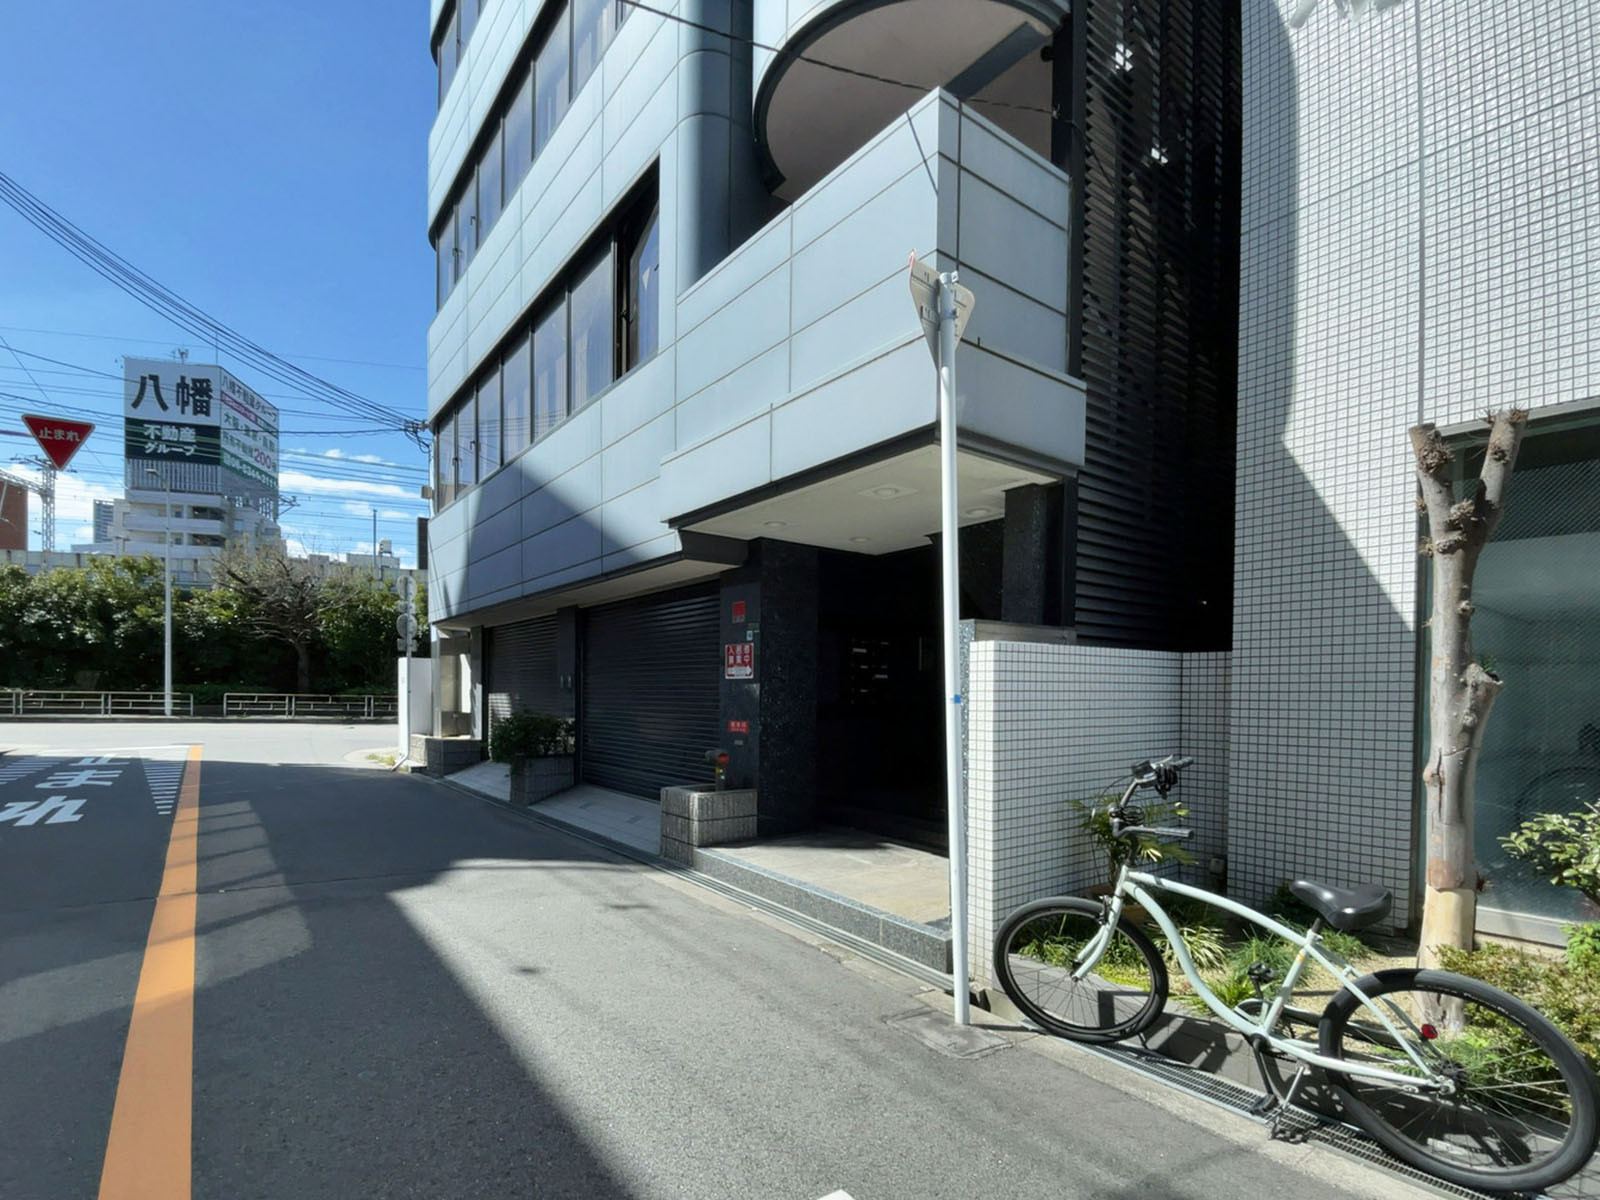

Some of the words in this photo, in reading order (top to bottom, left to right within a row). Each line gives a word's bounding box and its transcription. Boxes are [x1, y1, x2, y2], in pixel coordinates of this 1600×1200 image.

[131, 374, 213, 417] 八幡
[39, 427, 81, 442] 止まれ
[143, 424, 197, 442] 不動産
[144, 442, 198, 456] グループ
